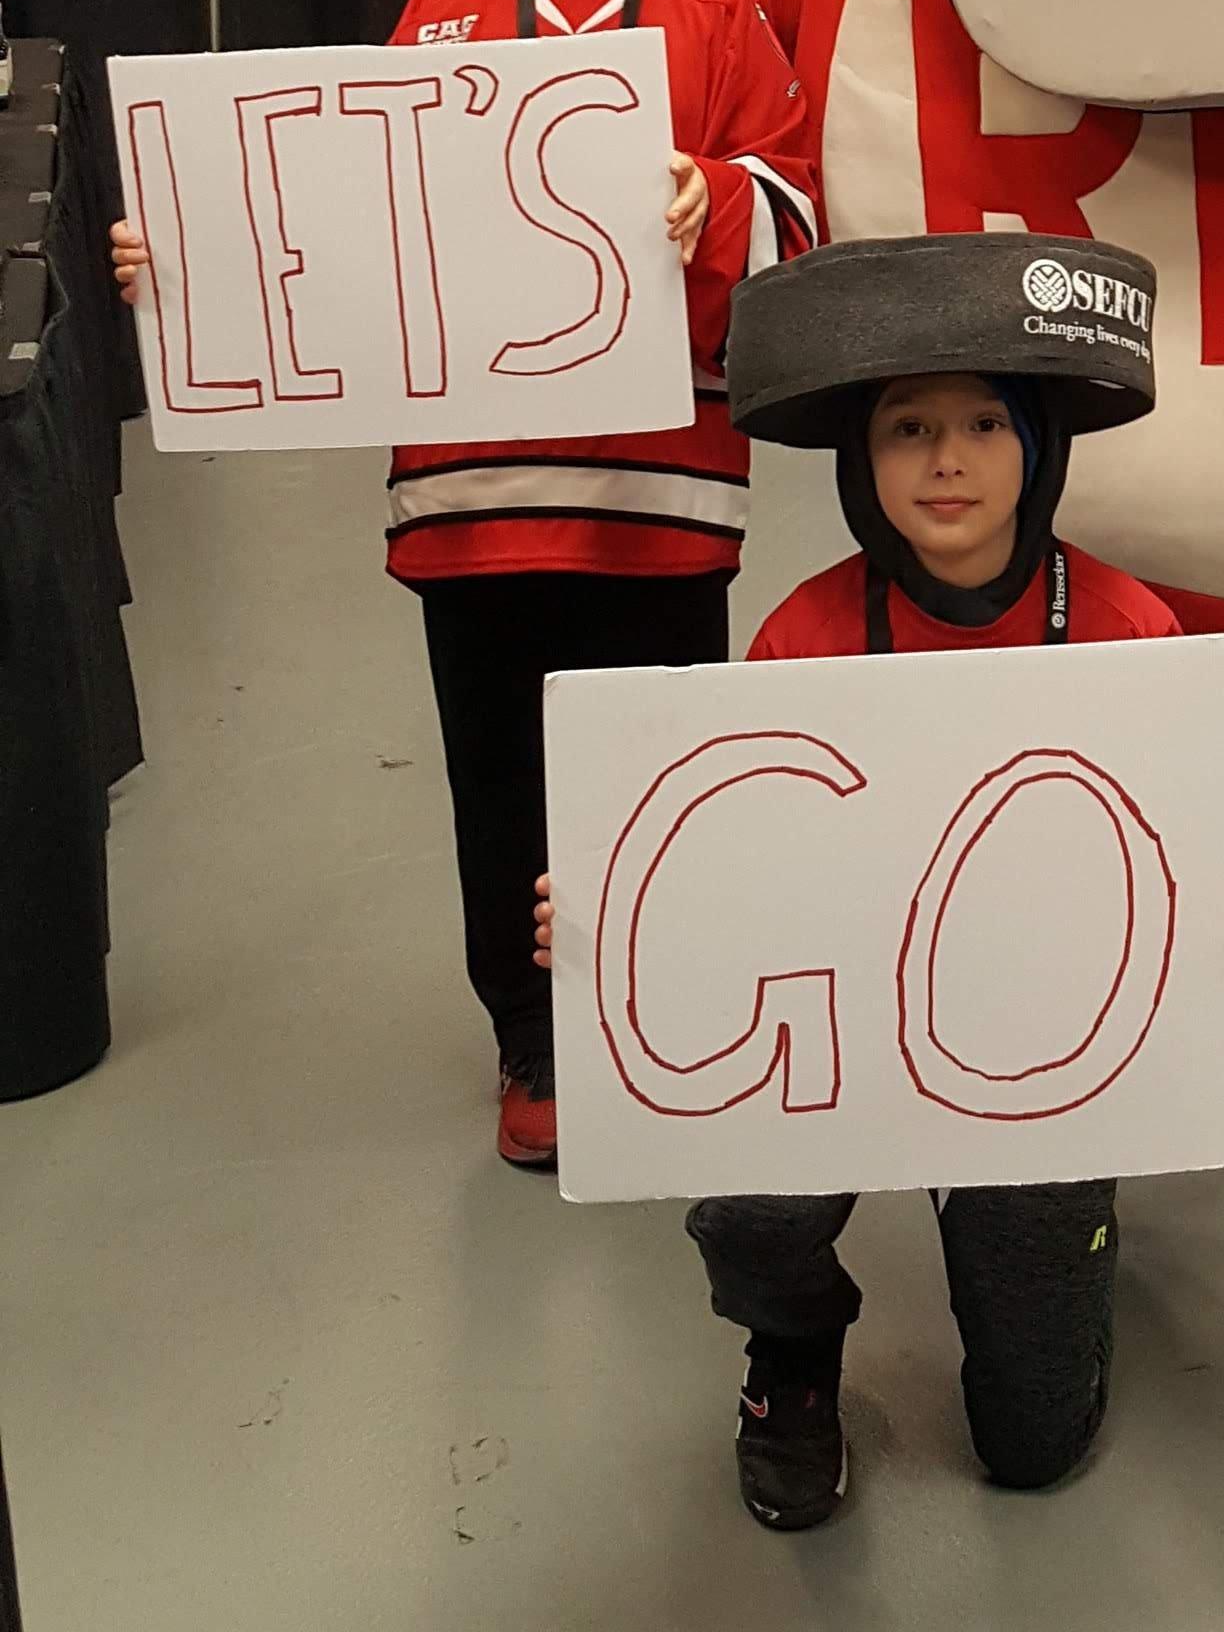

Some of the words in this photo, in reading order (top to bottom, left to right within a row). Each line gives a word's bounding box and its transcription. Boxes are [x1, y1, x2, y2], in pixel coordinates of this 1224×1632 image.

[128, 64, 639, 413] LET'S
[1023, 316, 1096, 345] Changing
[1096, 324, 1119, 345] lives
[1072, 270, 1153, 332] SEFCU
[595, 730, 1177, 1122] GO
